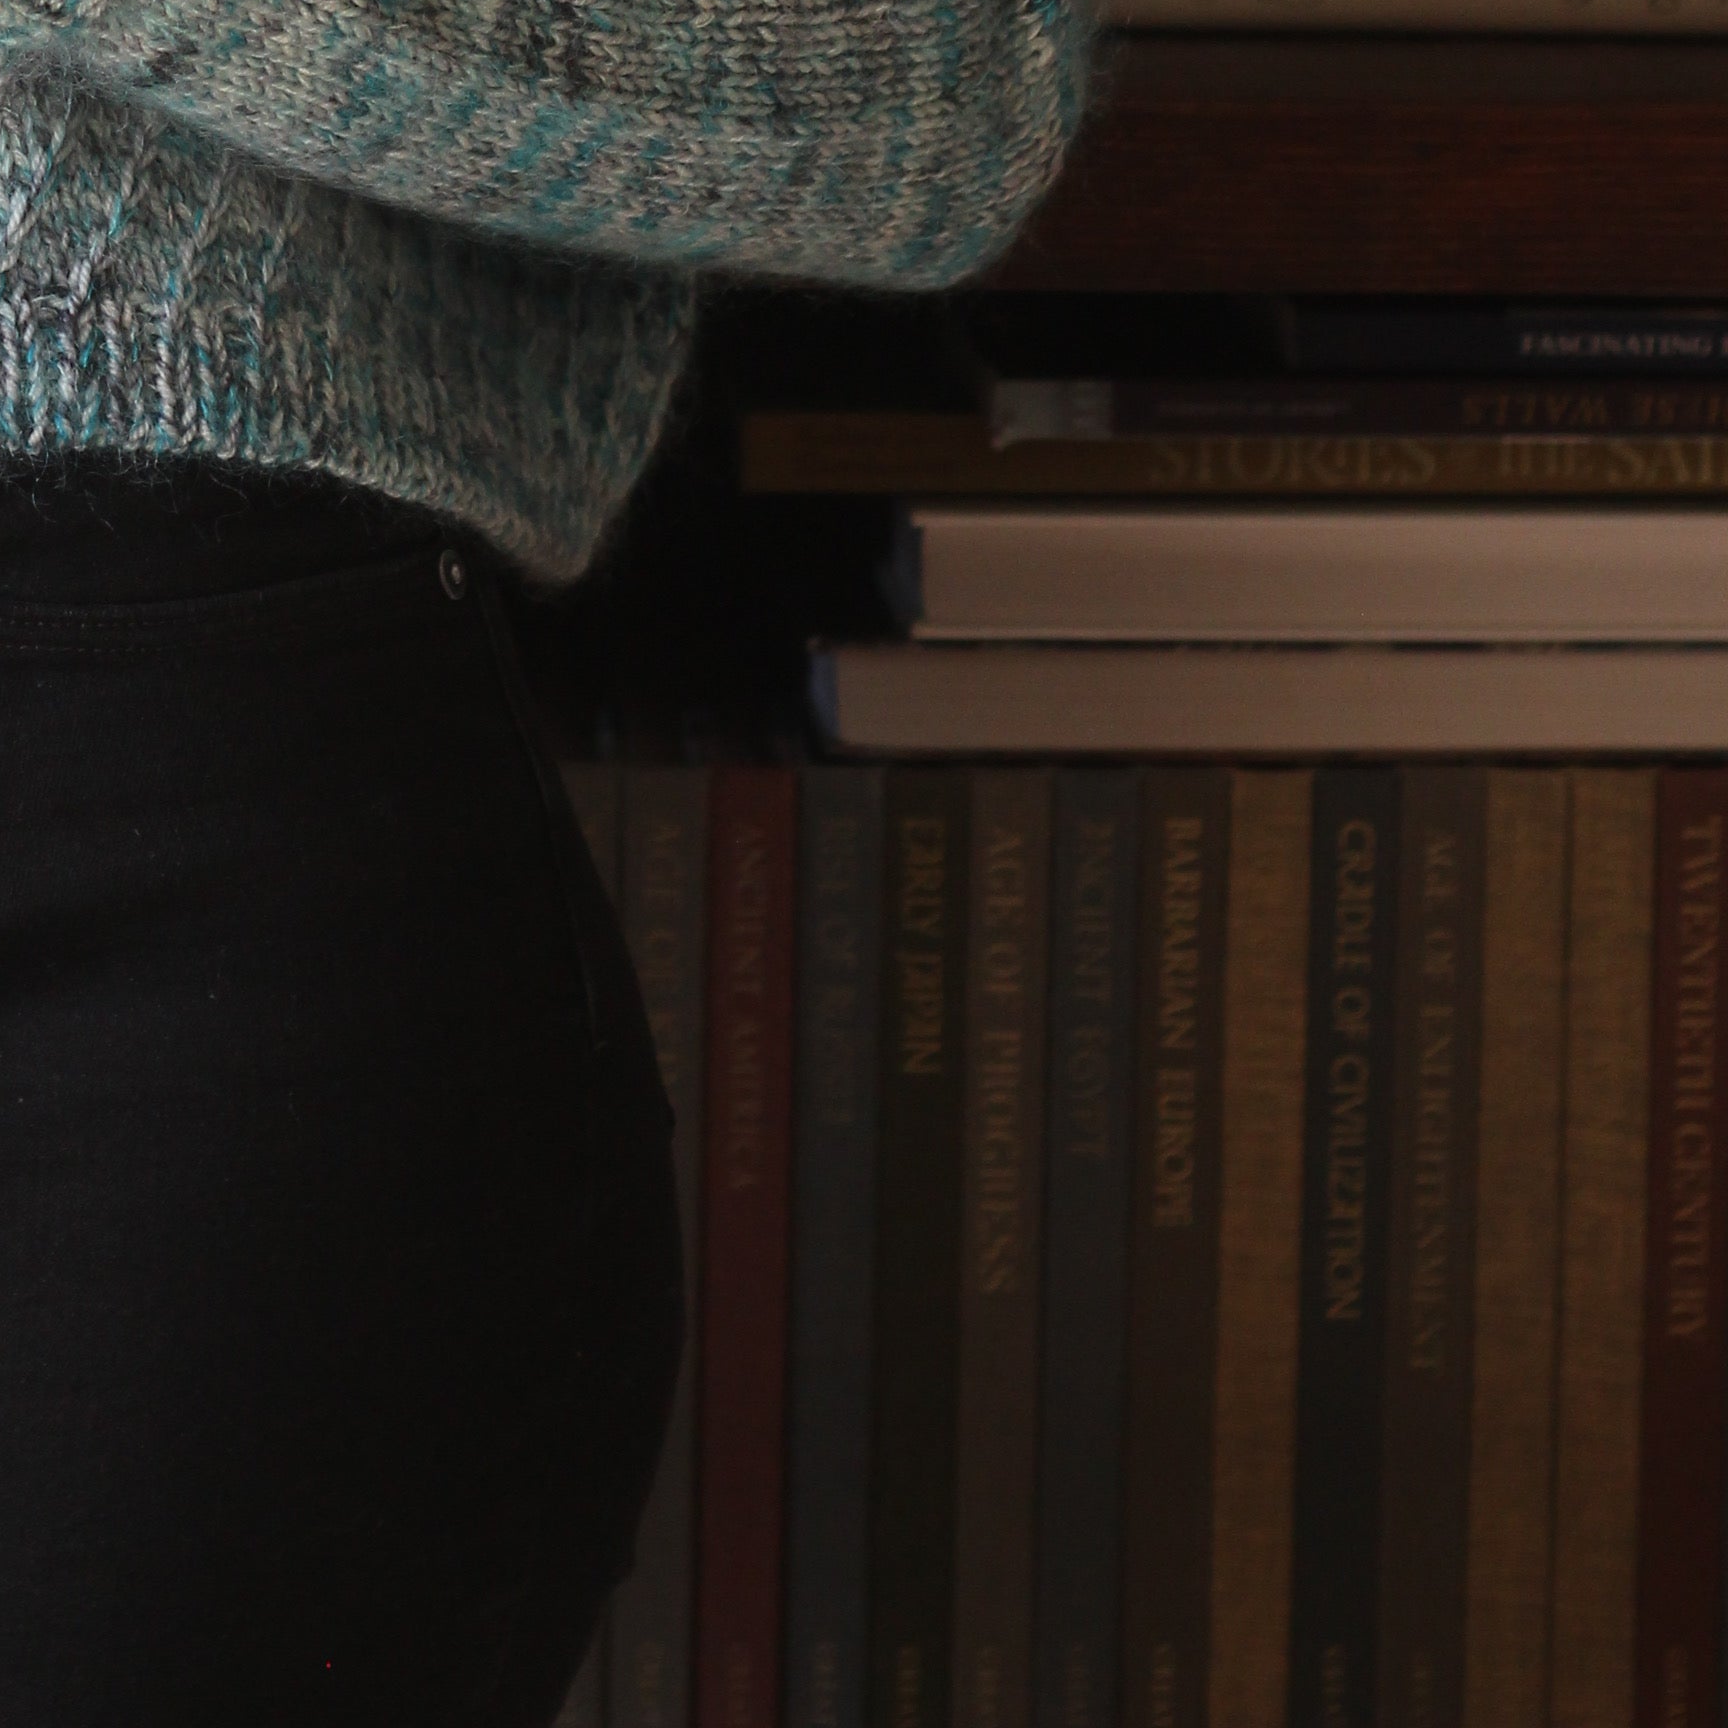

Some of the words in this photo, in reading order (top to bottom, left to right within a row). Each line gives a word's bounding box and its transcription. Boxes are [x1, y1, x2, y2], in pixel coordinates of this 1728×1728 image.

[1604, 436, 1728, 487] SAI
[901, 815, 949, 935] EARLY
[982, 826, 1026, 926] AGE
[1160, 815, 1204, 1051] BARBARIAN
[1333, 817, 1376, 974] CRADLE
[895, 951, 944, 1078] JAPAN
[980, 940, 1024, 1007] OF
[1331, 985, 1372, 1043] OF
[1675, 815, 1723, 1112] TWENTIETH
[976, 1027, 1024, 1296] PROGRESS
[1152, 1066, 1197, 1228] EUROPE
[1324, 1053, 1369, 1321] CIVILIZATION
[1666, 1121, 1713, 1338] CENTURY
